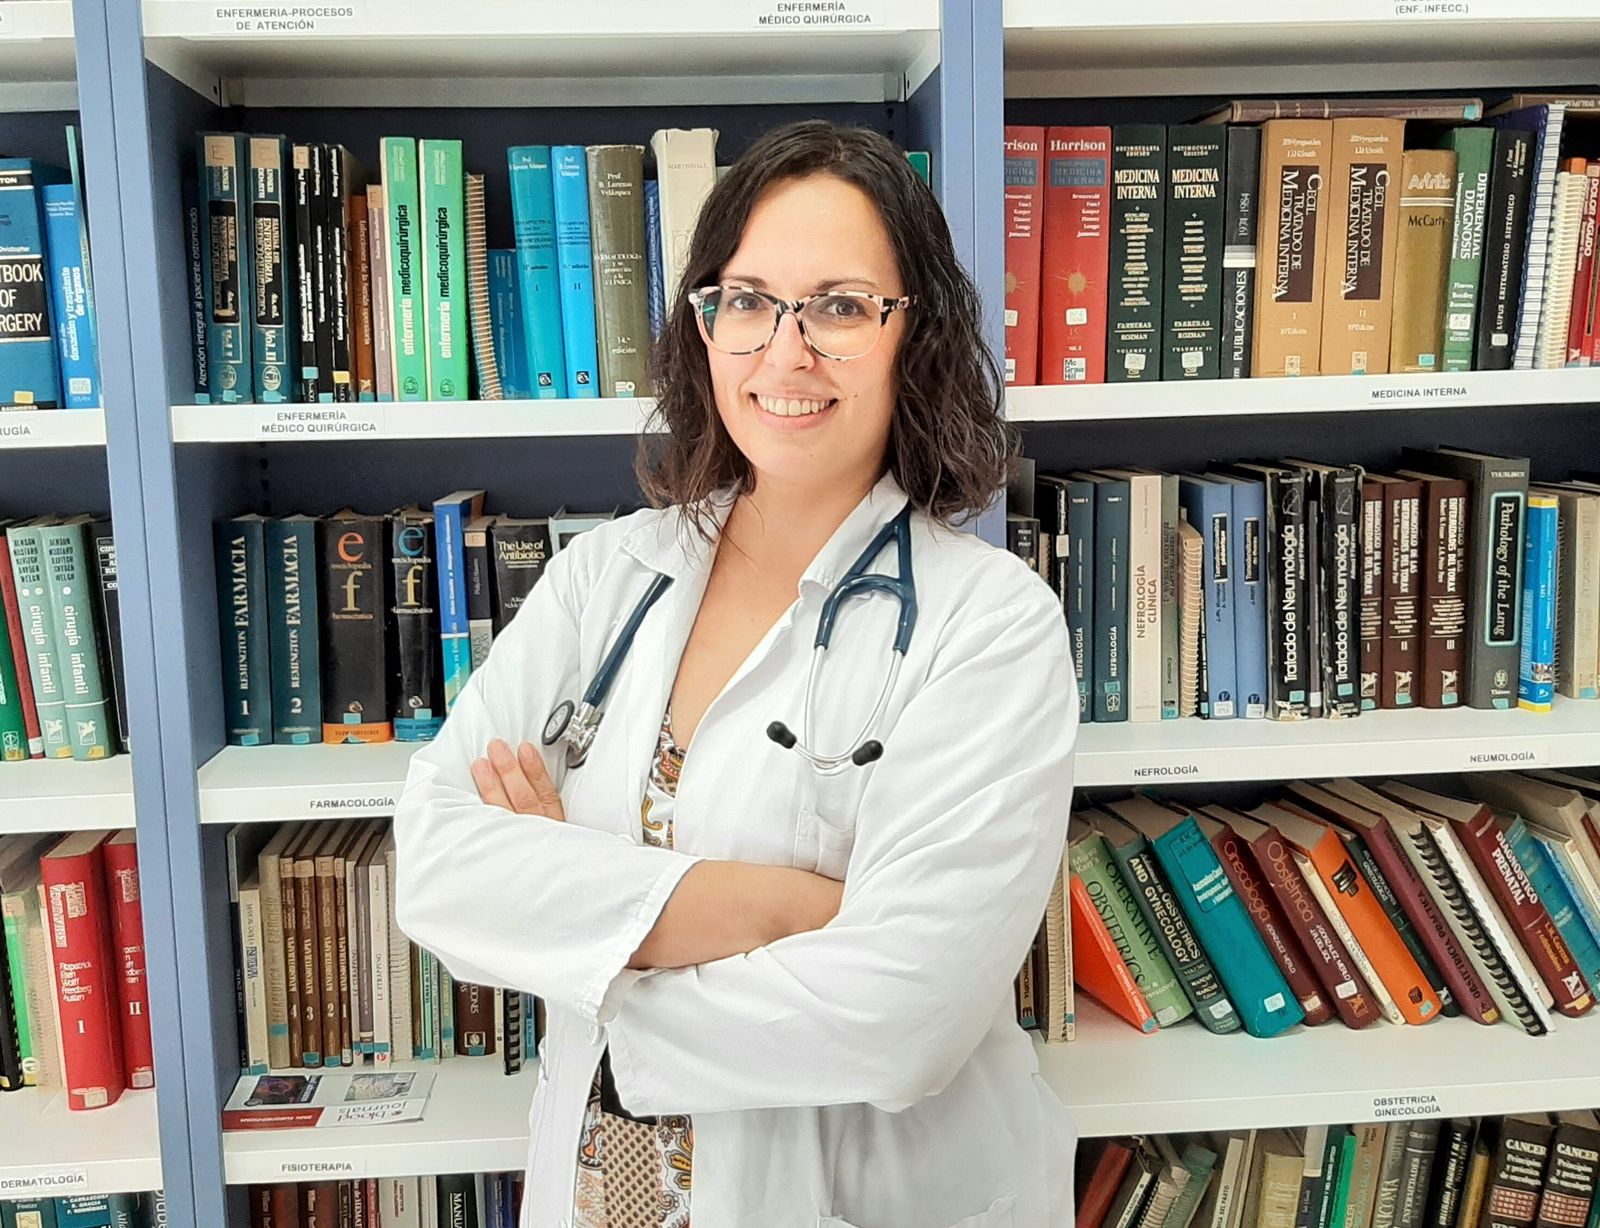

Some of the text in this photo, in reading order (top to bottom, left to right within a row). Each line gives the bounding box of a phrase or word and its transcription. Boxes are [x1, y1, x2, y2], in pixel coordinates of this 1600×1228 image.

[759, 13, 871, 24] MÉDICO QUIRÚRGICA
[777, 1, 846, 12] ENFERMERÍA
[1395, 4, 1469, 14] (ENF. INFECC.)
[236, 19, 315, 30] DE ATENCIÓN
[1050, 140, 1106, 151] Harrison
[1114, 169, 1160, 184] MEDICINA
[1172, 168, 1220, 183] MEDICINA
[1372, 169, 1390, 212] CECIL
[1117, 185, 1157, 199] INTERNA
[1174, 184, 1216, 199] INTERNA
[1305, 173, 1323, 215] CECIL
[1290, 192, 1305, 270] TRATADO DE
[1340, 166, 1367, 296] MEDICINA INTERNA
[1359, 189, 1373, 266] TRATADO DE
[1461, 189, 1475, 260] DIAGNOSIS
[1471, 172, 1488, 259] DIFFERENTIAL
[1583, 178, 1598, 257] DOLOR AGUDO
[394, 205, 412, 295] medicoquirúrgica
[1271, 170, 1299, 300] MEDICINA INTERNA
[435, 208, 451, 298] medicoquirúrgica
[1496, 194, 1515, 330] LUPUS ERITEMATOSO SISTÉMICO
[62, 267, 74, 312] trasplante
[72, 267, 85, 317] de órganos
[192, 261, 205, 299] paciente
[0, 289, 17, 308] OF
[193, 302, 203, 310] al
[0, 313, 42, 334] RGERY
[194, 312, 206, 345] integral
[1233, 271, 1247, 361] PUBLICACIONES
[68, 321, 80, 361] donación
[264, 329, 277, 347] Vol.
[197, 347, 208, 387] Atención
[1372, 387, 1467, 399] MEDICINA INTERNA
[261, 421, 376, 433] MÉDICO QUIRÚRGICA
[277, 410, 347, 421] ENFERMERÍA
[337, 532, 364, 562] e
[398, 526, 425, 557] e
[497, 540, 544, 550] The Use of
[499, 550, 546, 560] Antibiotics
[1364, 556, 1373, 569] DEL
[1400, 553, 1410, 567] DEL
[1447, 553, 1457, 567] DEL
[1493, 501, 1515, 636] Pathology of the Lung
[341, 571, 364, 611] f
[401, 564, 424, 606] f
[1364, 570, 1373, 595] TORAX
[1400, 568, 1409, 593] TORAX
[1447, 567, 1456, 592] TORAX
[231, 536, 249, 690] REMINGTON FARMACIA
[283, 535, 300, 688] REMINGTON FARMACIA
[1133, 565, 1146, 639] NEFROLOGÍA
[1145, 579, 1157, 624] CLÍNICA
[1281, 525, 1297, 683] Tratado de Neumología
[1334, 525, 1349, 682] Tratado de Neumología
[30, 605, 56, 694] cirugía infantil
[64, 605, 89, 695] cirugía infantil
[1074, 627, 1084, 678] NEFROLOGÍA
[1107, 626, 1118, 677] NEFROLOGÍA
[241, 700, 250, 715] 1
[290, 697, 302, 714] 2
[1134, 764, 1199, 777] NEFROLOGÍA
[1470, 751, 1536, 763] NEUMOLOGÍA
[310, 797, 395, 809] FARMACOLOGÍA
[1072, 848, 1097, 867] Munro
[1495, 831, 1539, 905] DIAGNOSTICO
[1491, 849, 1524, 906] PRENATAL
[1105, 862, 1162, 961] OPERATIVE
[1129, 857, 1192, 965] AND GYNECOLOGY
[1161, 892, 1200, 959] OBSTETRICS
[1086, 880, 1145, 986] OBSTETRICS
[336, 1109, 385, 1122] blood
[337, 1100, 406, 1115] journals
[1373, 1095, 1436, 1106] OBSTETRICIA
[1375, 1105, 1441, 1117] GINECOLOGÍA
[1505, 1138, 1548, 1157] CANCER
[1556, 1143, 1599, 1162] CANCER
[281, 1163, 352, 1172] FISIOTERAPIA
